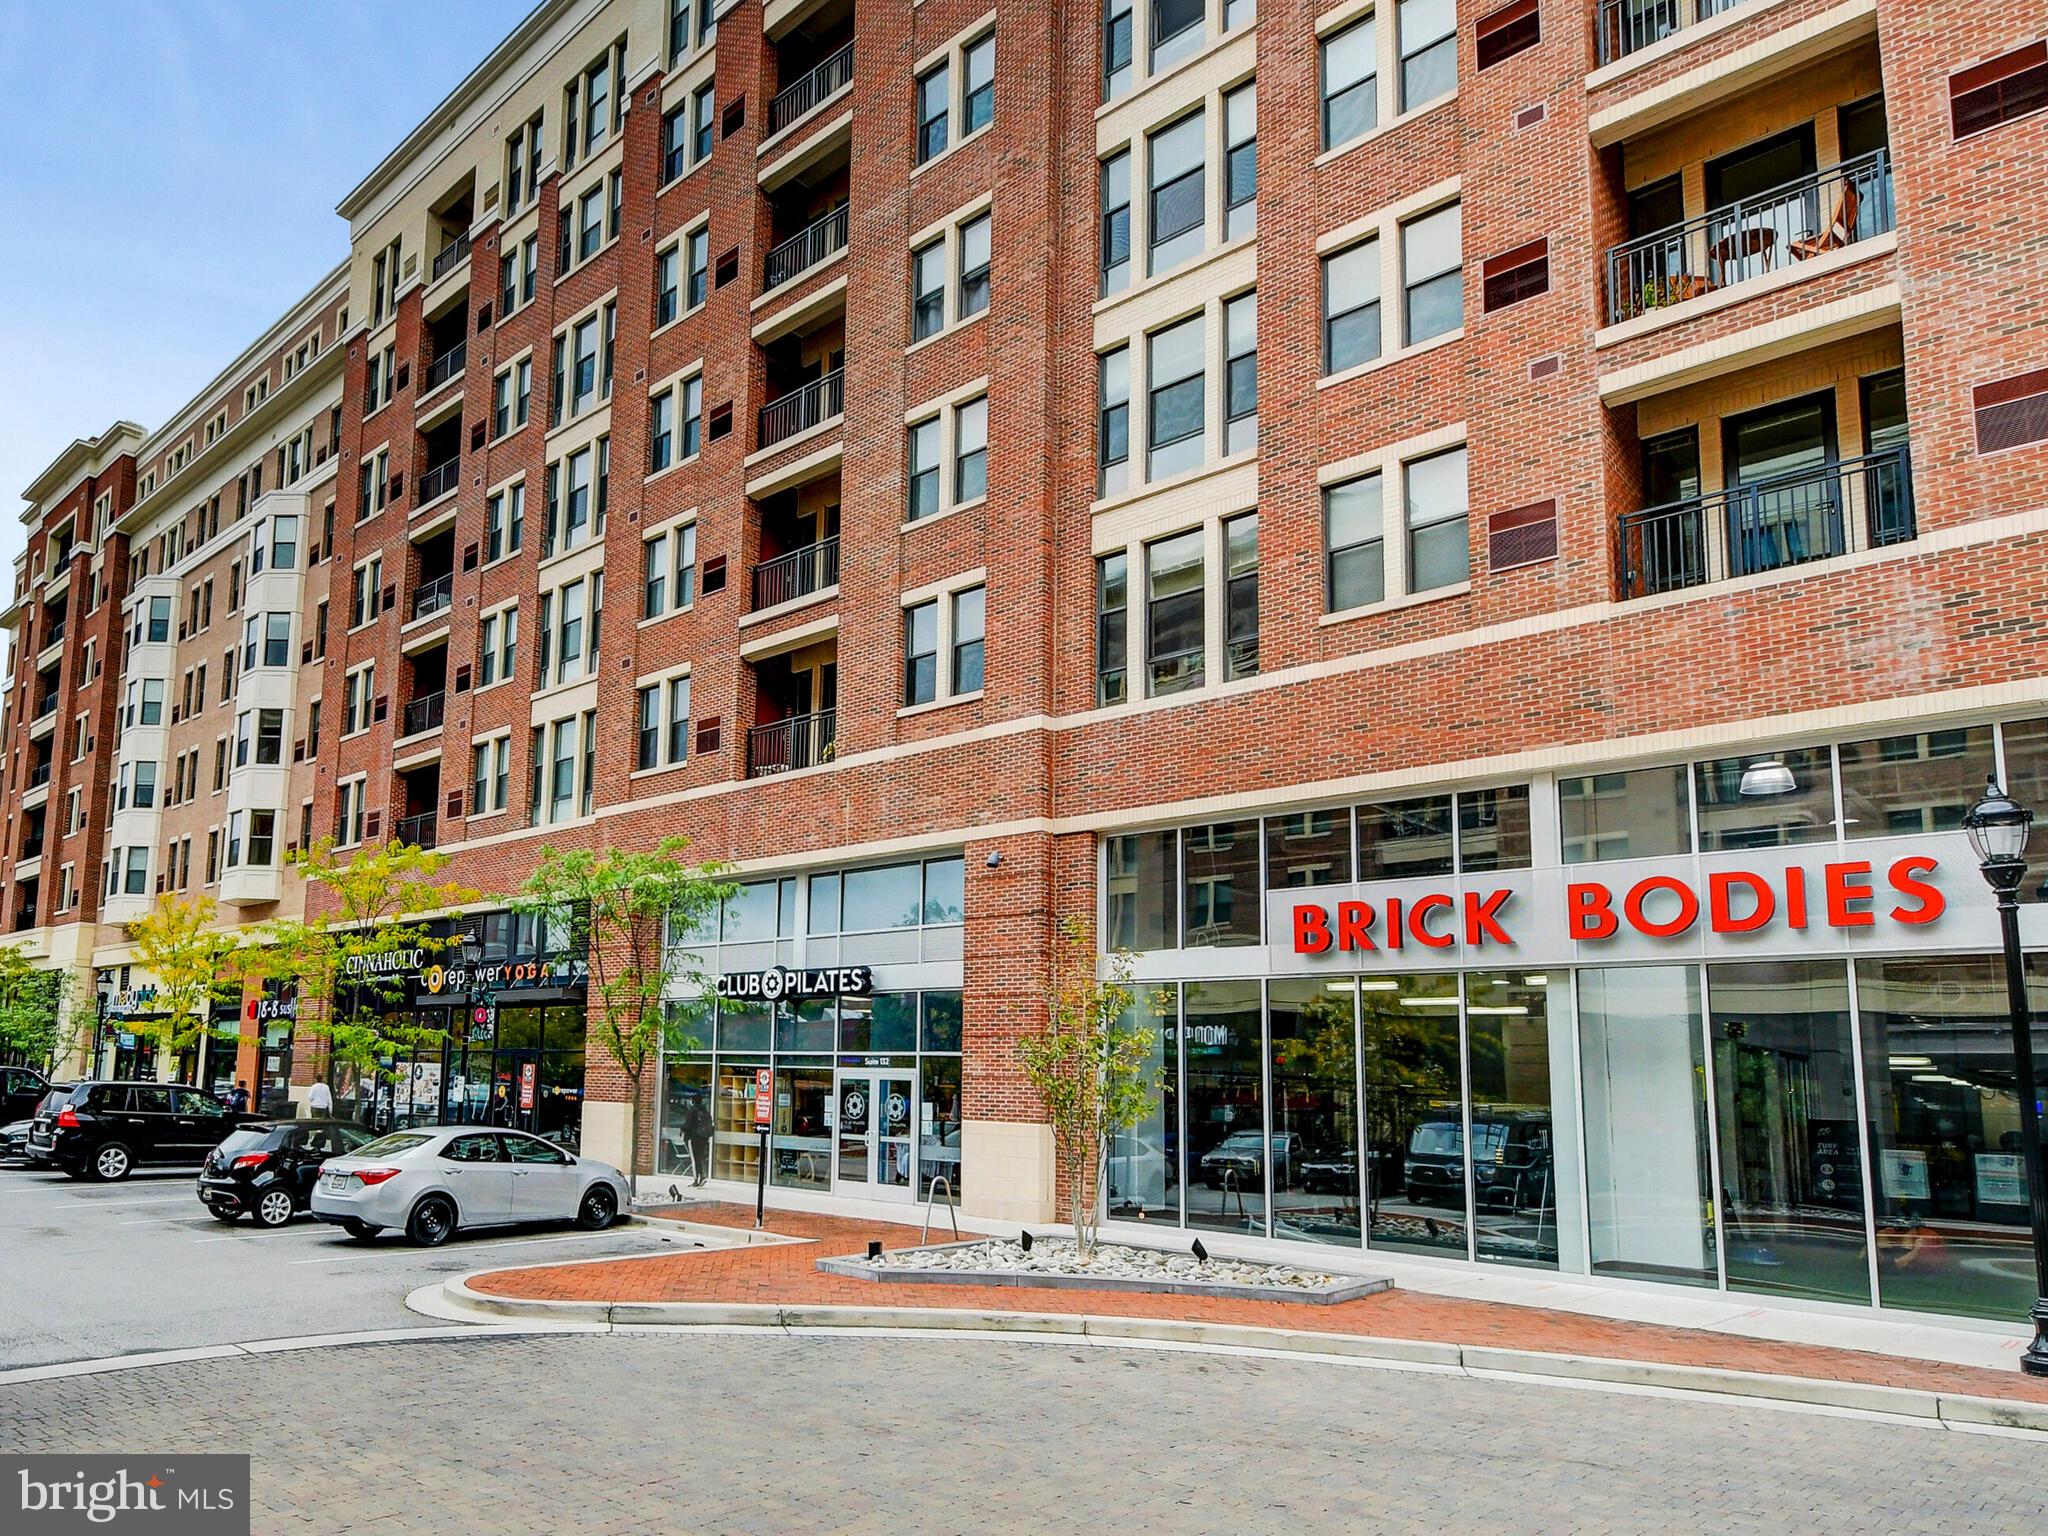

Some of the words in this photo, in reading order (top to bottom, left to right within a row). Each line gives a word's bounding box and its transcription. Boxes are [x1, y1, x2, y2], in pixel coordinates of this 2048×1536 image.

[1293, 889, 1514, 954] BRICK
[1567, 856, 1946, 940] BODIES
[421, 964, 501, 993] corepwer
[503, 963, 551, 980] YOGA
[716, 974, 760, 996] CLUB
[785, 968, 862, 994] PILATES
[864, 1057, 879, 1066] Suite
[880, 1057, 890, 1066] 132
